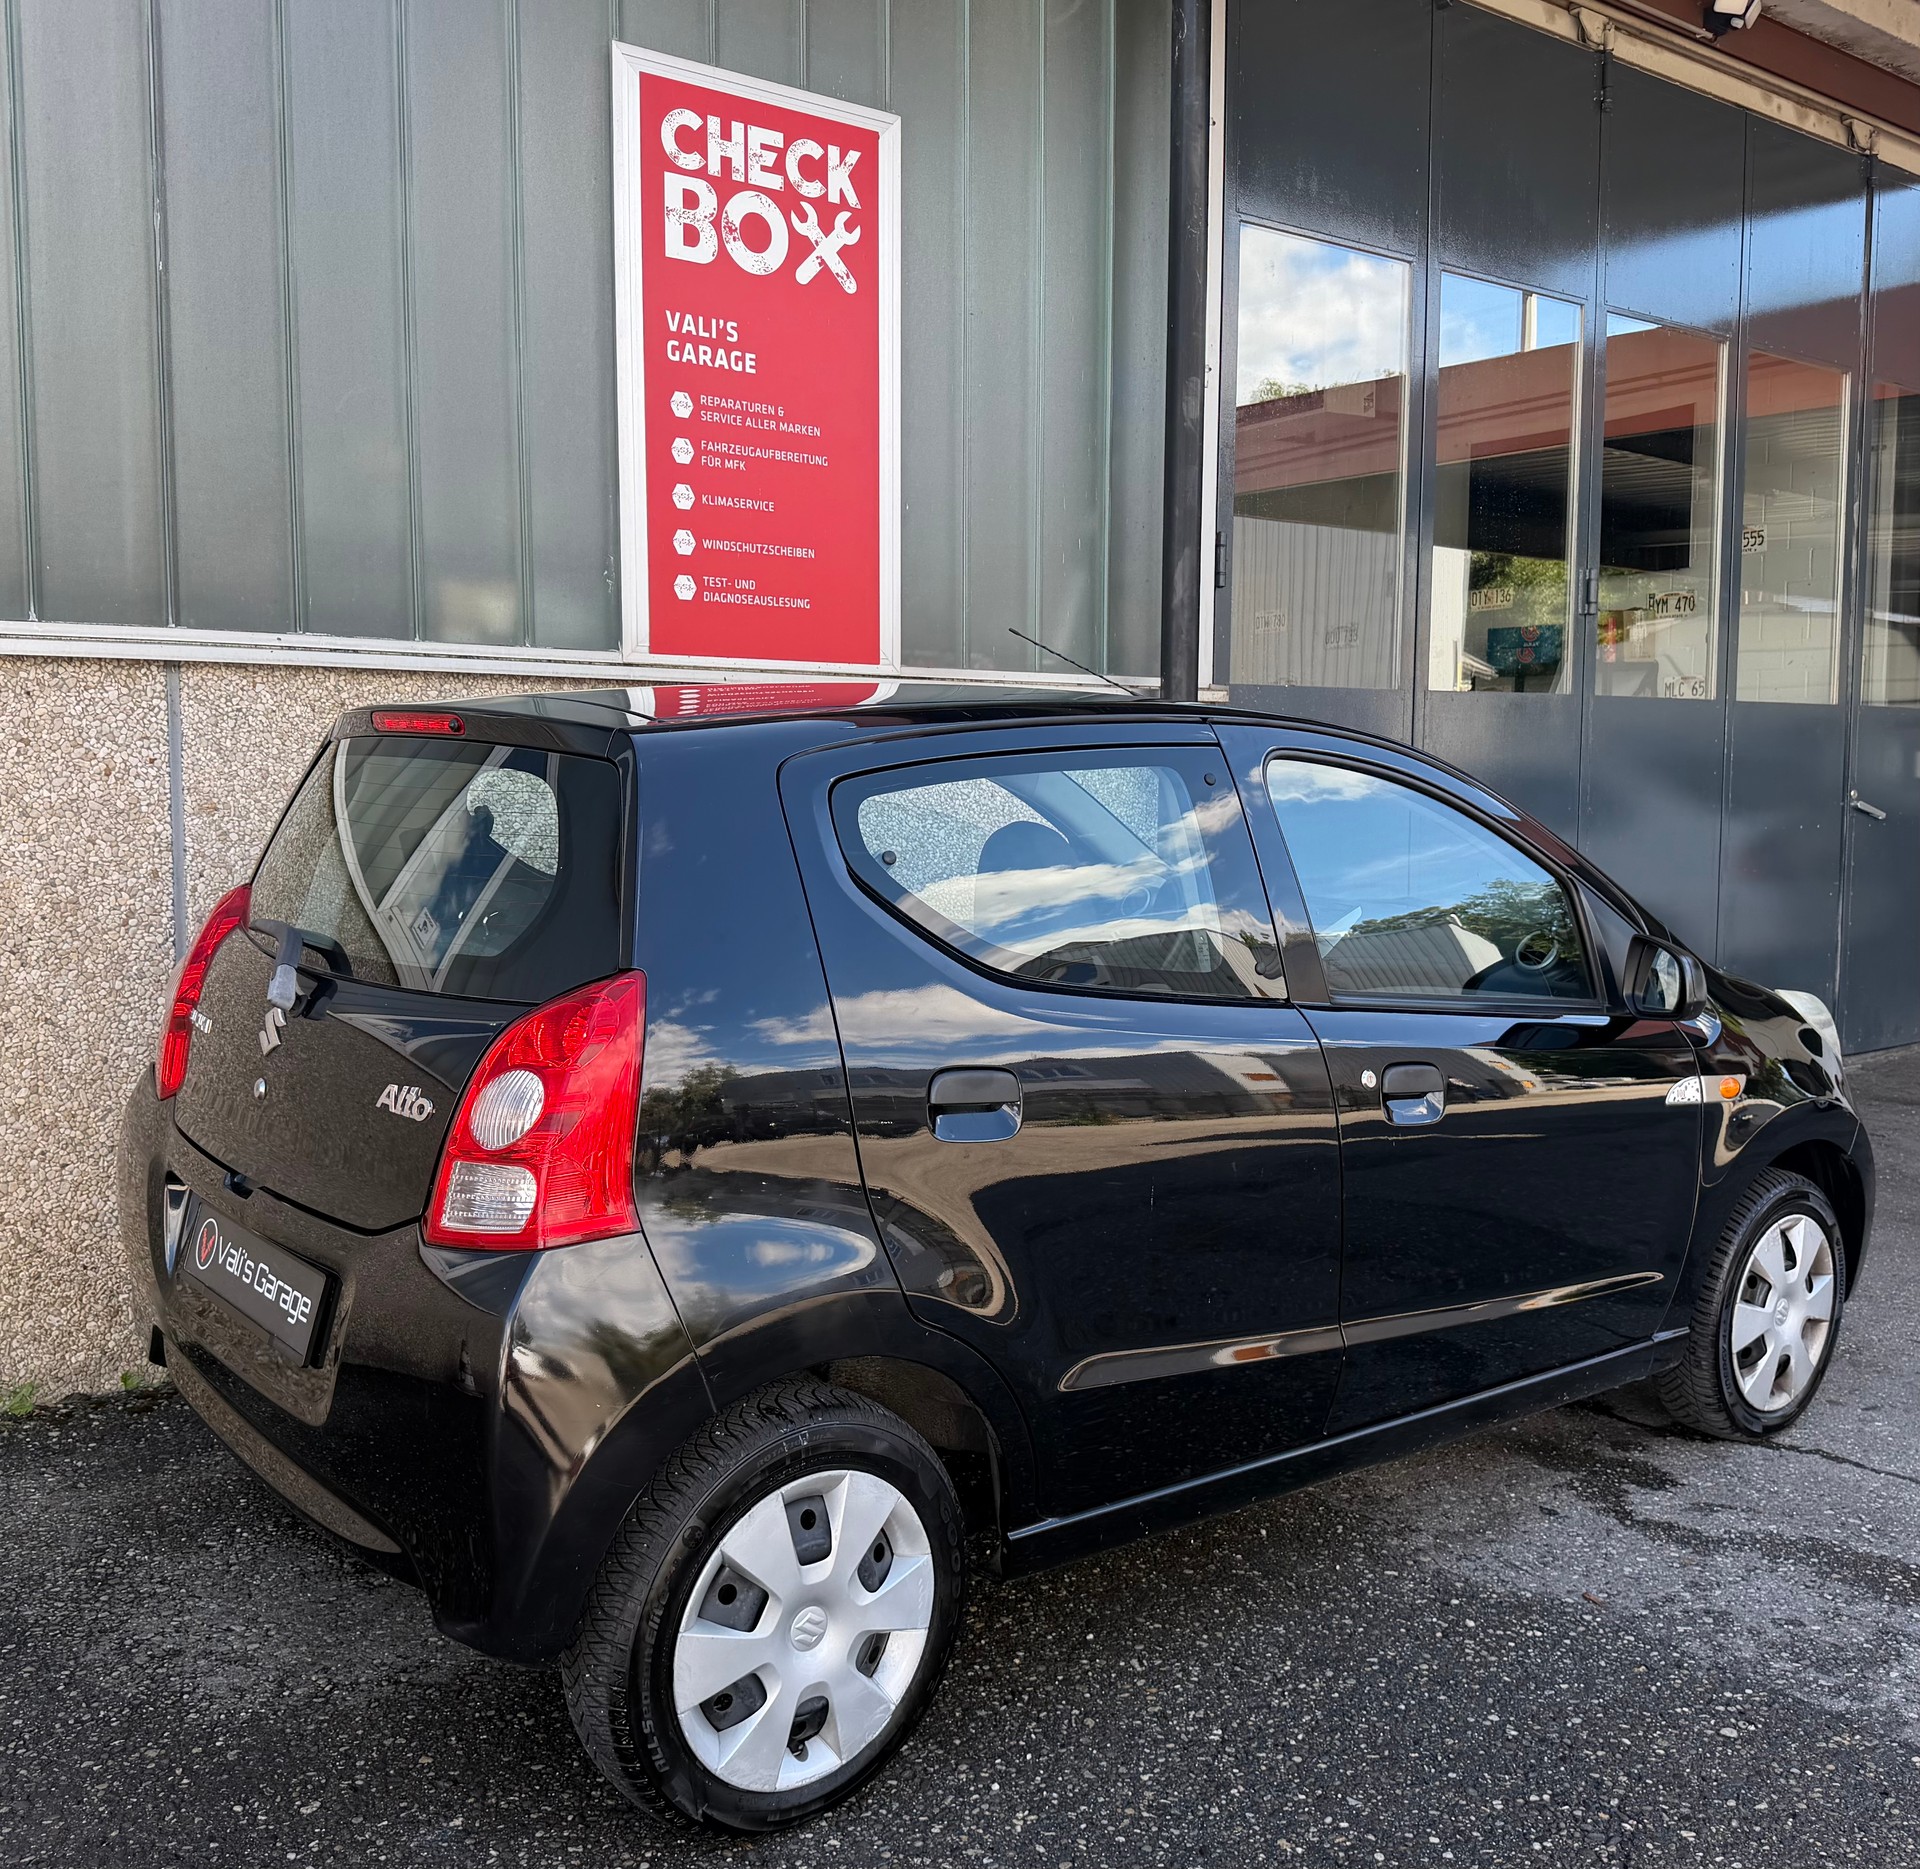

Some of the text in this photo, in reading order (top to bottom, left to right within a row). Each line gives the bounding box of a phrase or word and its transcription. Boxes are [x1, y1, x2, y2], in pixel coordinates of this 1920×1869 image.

[661, 108, 861, 209] CHECK
[665, 309, 739, 343] VALI'S
[666, 340, 757, 374] GARAGE
[700, 395, 785, 417] REPARATUREN &
[700, 410, 821, 437] SERVICE ALLER MARKEN
[701, 440, 829, 467] FAHRZEUGAUFBEREITUNG
[701, 455, 746, 471] FÜR MFK
[702, 494, 775, 512] KLIMASERVICE
[702, 538, 815, 559] WINDSCHUTZSCHEIBEN
[703, 576, 756, 590] TEST- UND
[703, 591, 811, 609] DIAGNOSEAUSLESUNG
[1495, 587, 1511, 604] 136
[1674, 595, 1696, 612] 470
[375, 1083, 434, 1122] Alto
[218, 1235, 312, 1325] Vali's Garage
